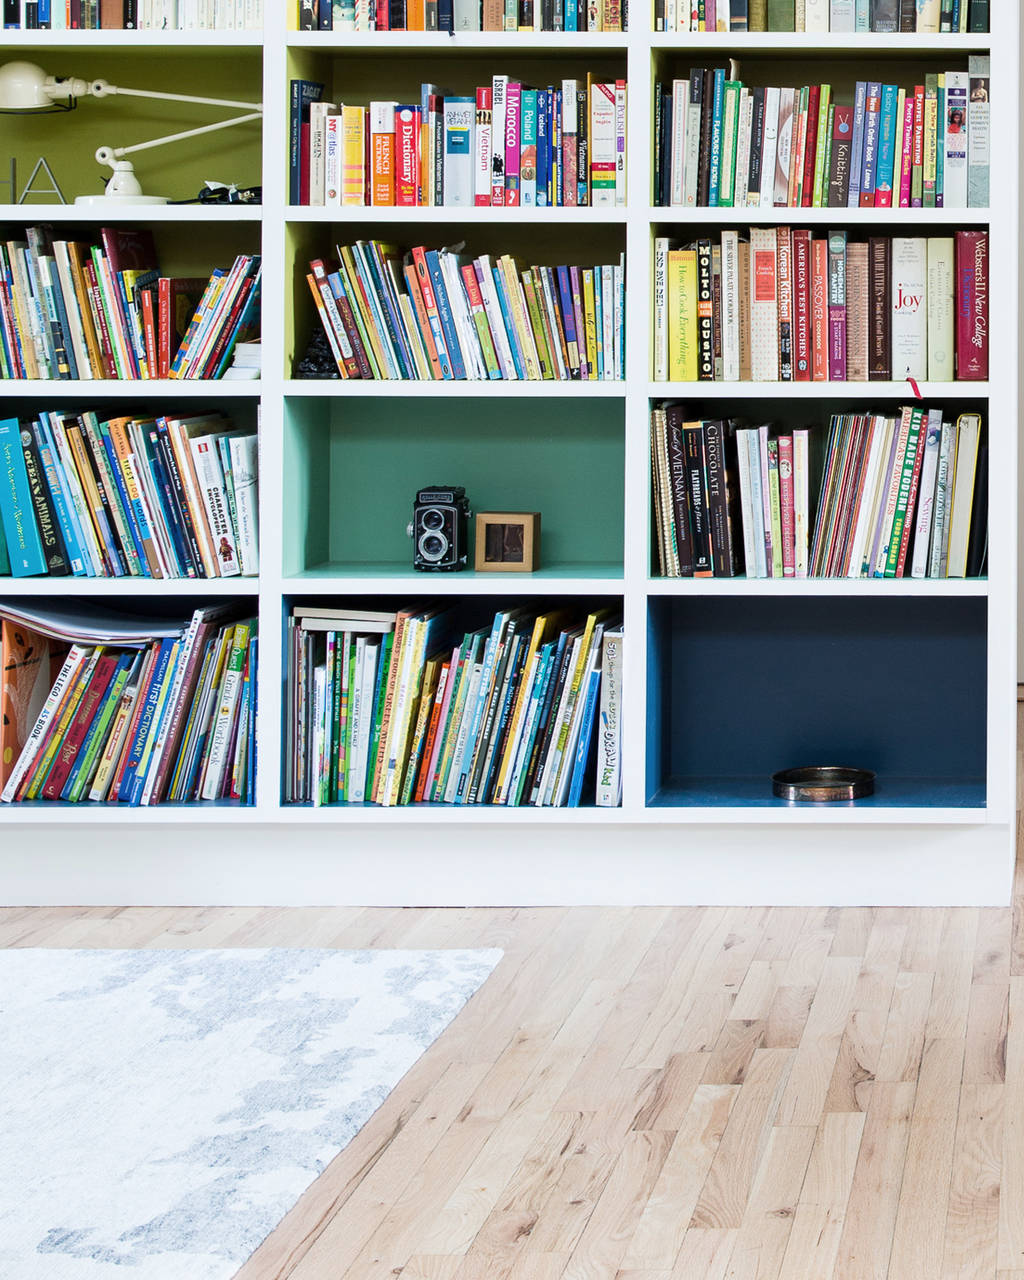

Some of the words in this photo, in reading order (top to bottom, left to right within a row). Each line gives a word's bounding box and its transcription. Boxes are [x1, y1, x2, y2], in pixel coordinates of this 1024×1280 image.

[506, 96, 518, 147] Morocco
[401, 125, 412, 182] Dictionary
[481, 129, 489, 171] Vietnam
[780, 246, 789, 278] Korean
[912, 413, 921, 431] KID
[906, 436, 918, 465] MADE
[899, 469, 912, 511] MODERN
